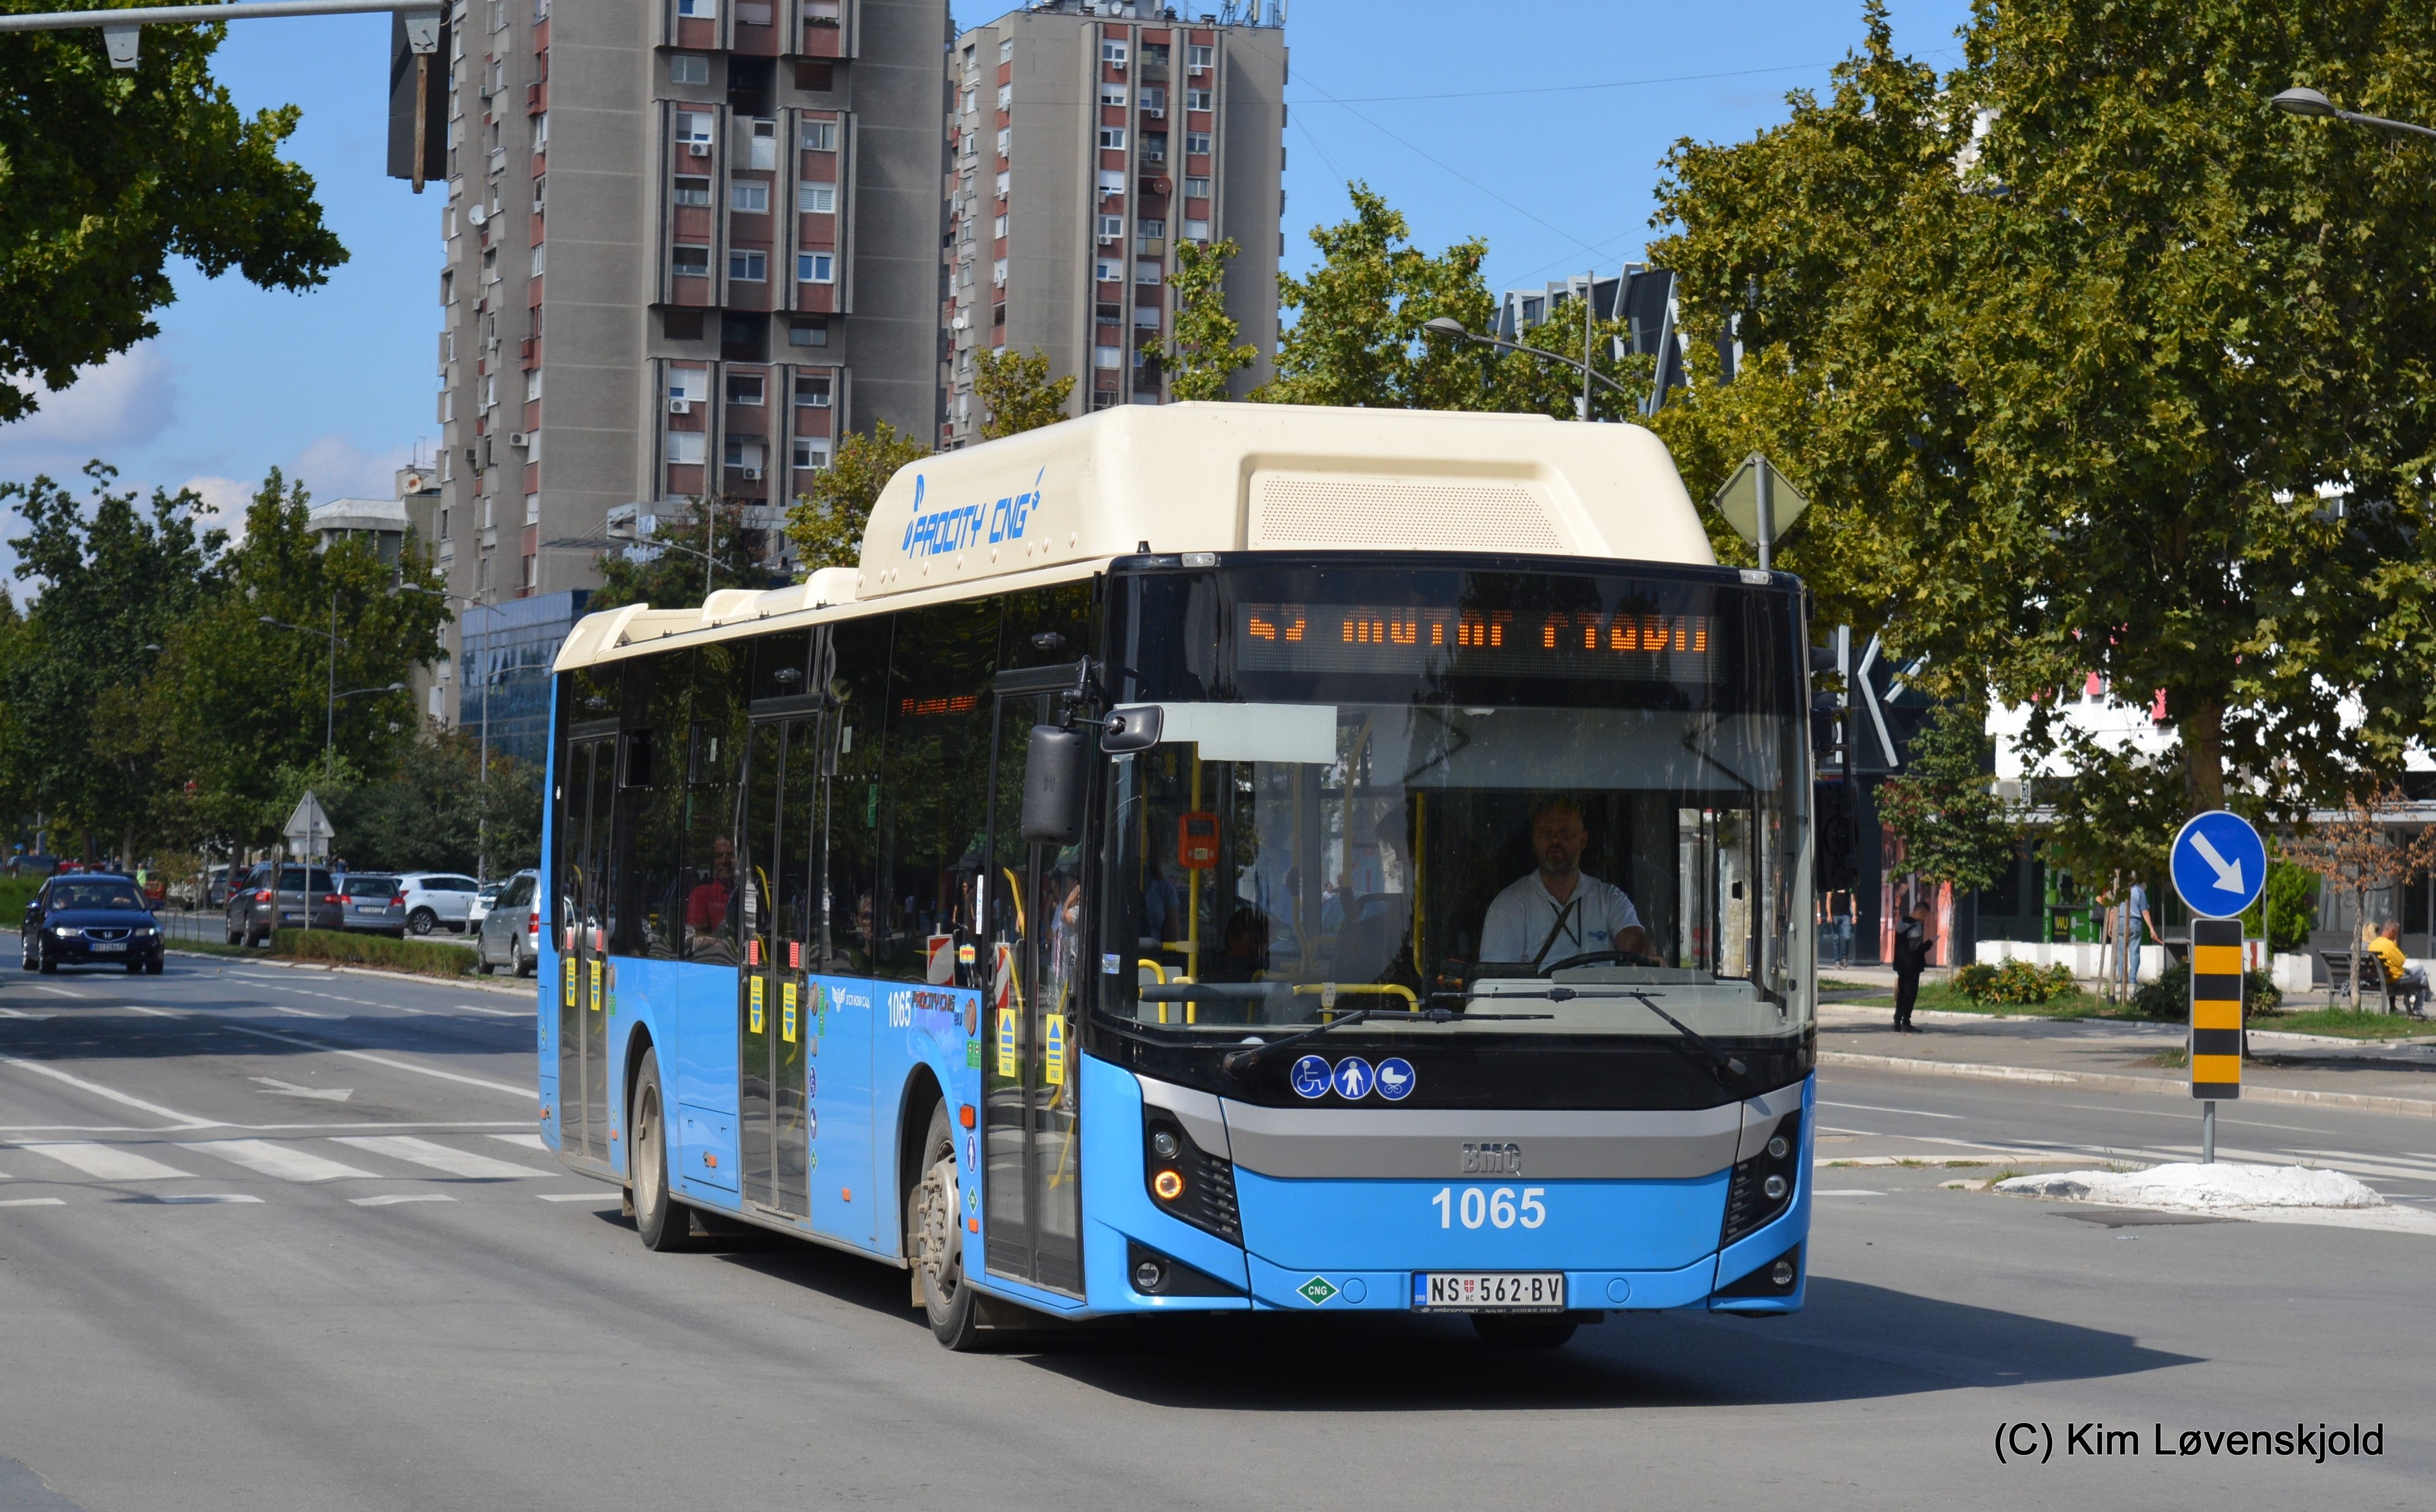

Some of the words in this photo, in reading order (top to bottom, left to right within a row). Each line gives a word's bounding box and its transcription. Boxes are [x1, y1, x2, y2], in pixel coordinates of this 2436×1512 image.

[909, 503, 986, 559] PROCITY
[989, 492, 1031, 544] CNG
[888, 991, 911, 1027] 1065
[1462, 1143, 1521, 1173] BMC
[1432, 1187, 1546, 1229] 1065
[1308, 1286, 1327, 1295] CNG
[1432, 1277, 1459, 1302] NS
